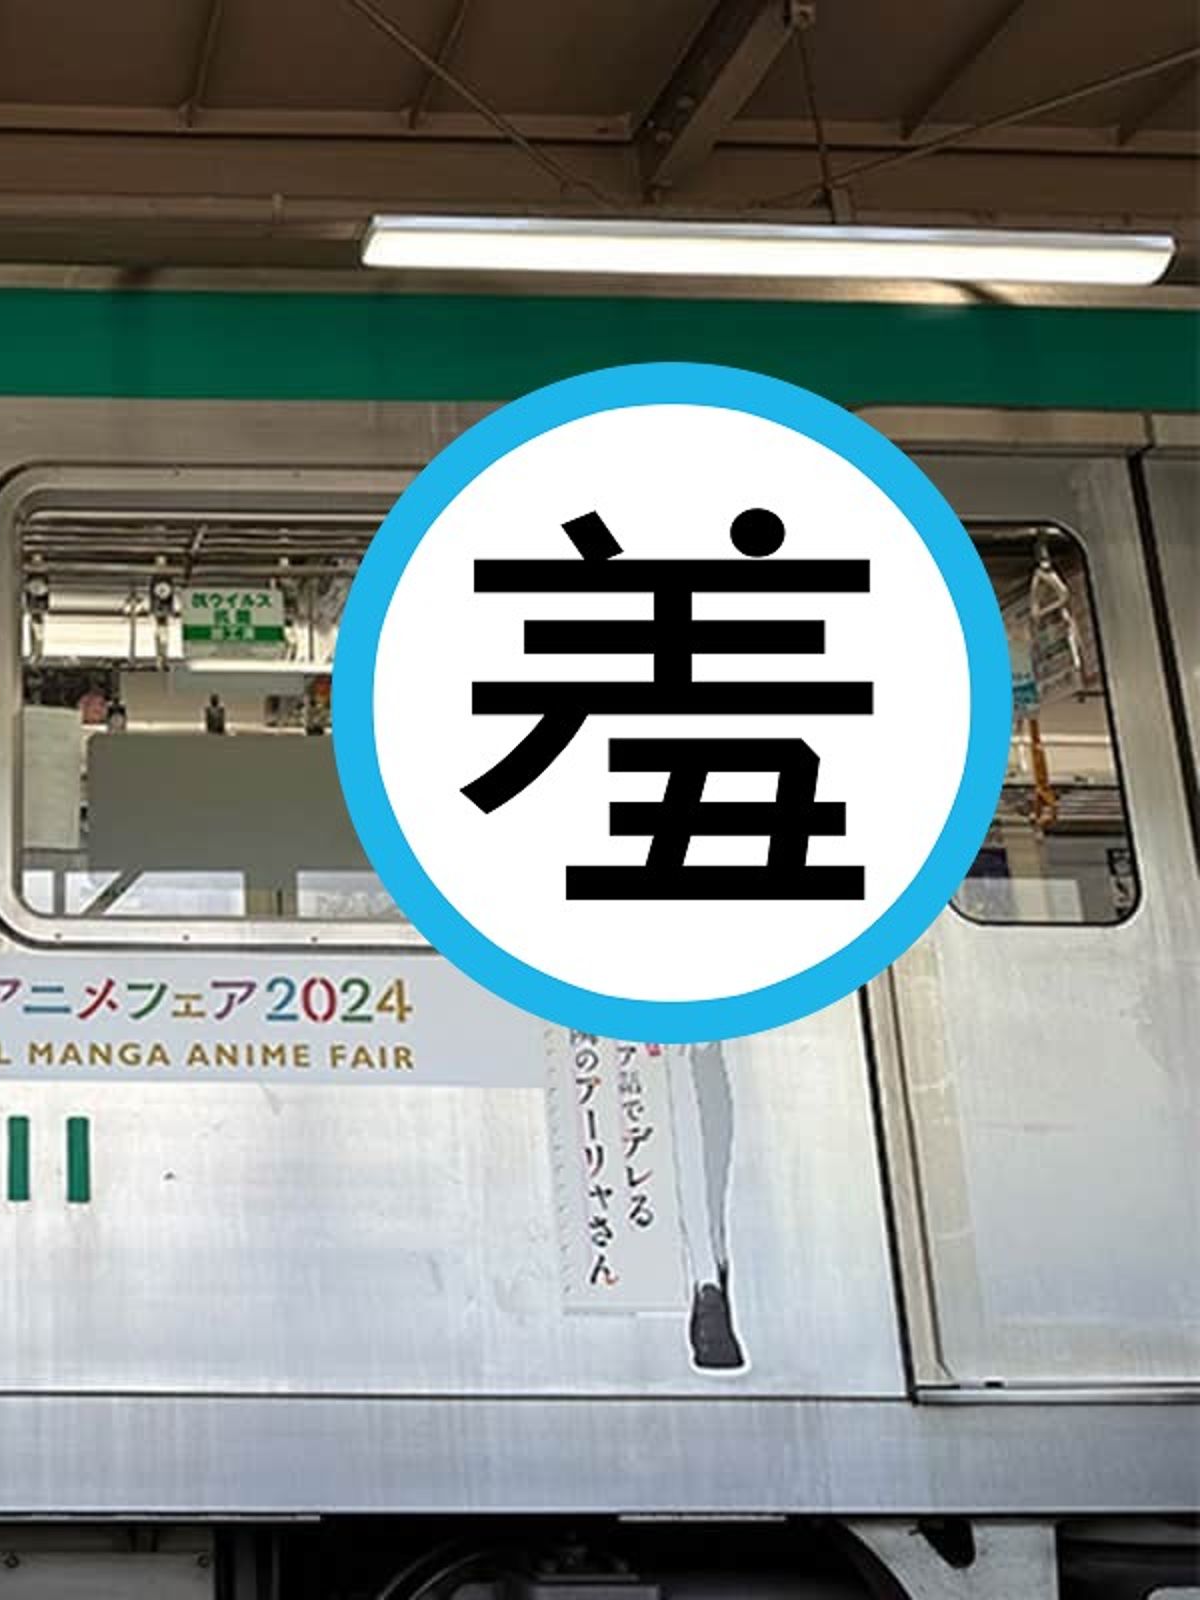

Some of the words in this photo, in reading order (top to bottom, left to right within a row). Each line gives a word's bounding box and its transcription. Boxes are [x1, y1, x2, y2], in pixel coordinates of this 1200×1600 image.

[28, 1042, 170, 1066] MANGA
[187, 1043, 310, 1067] ANIME
[330, 1045, 413, 1069] FAIR
